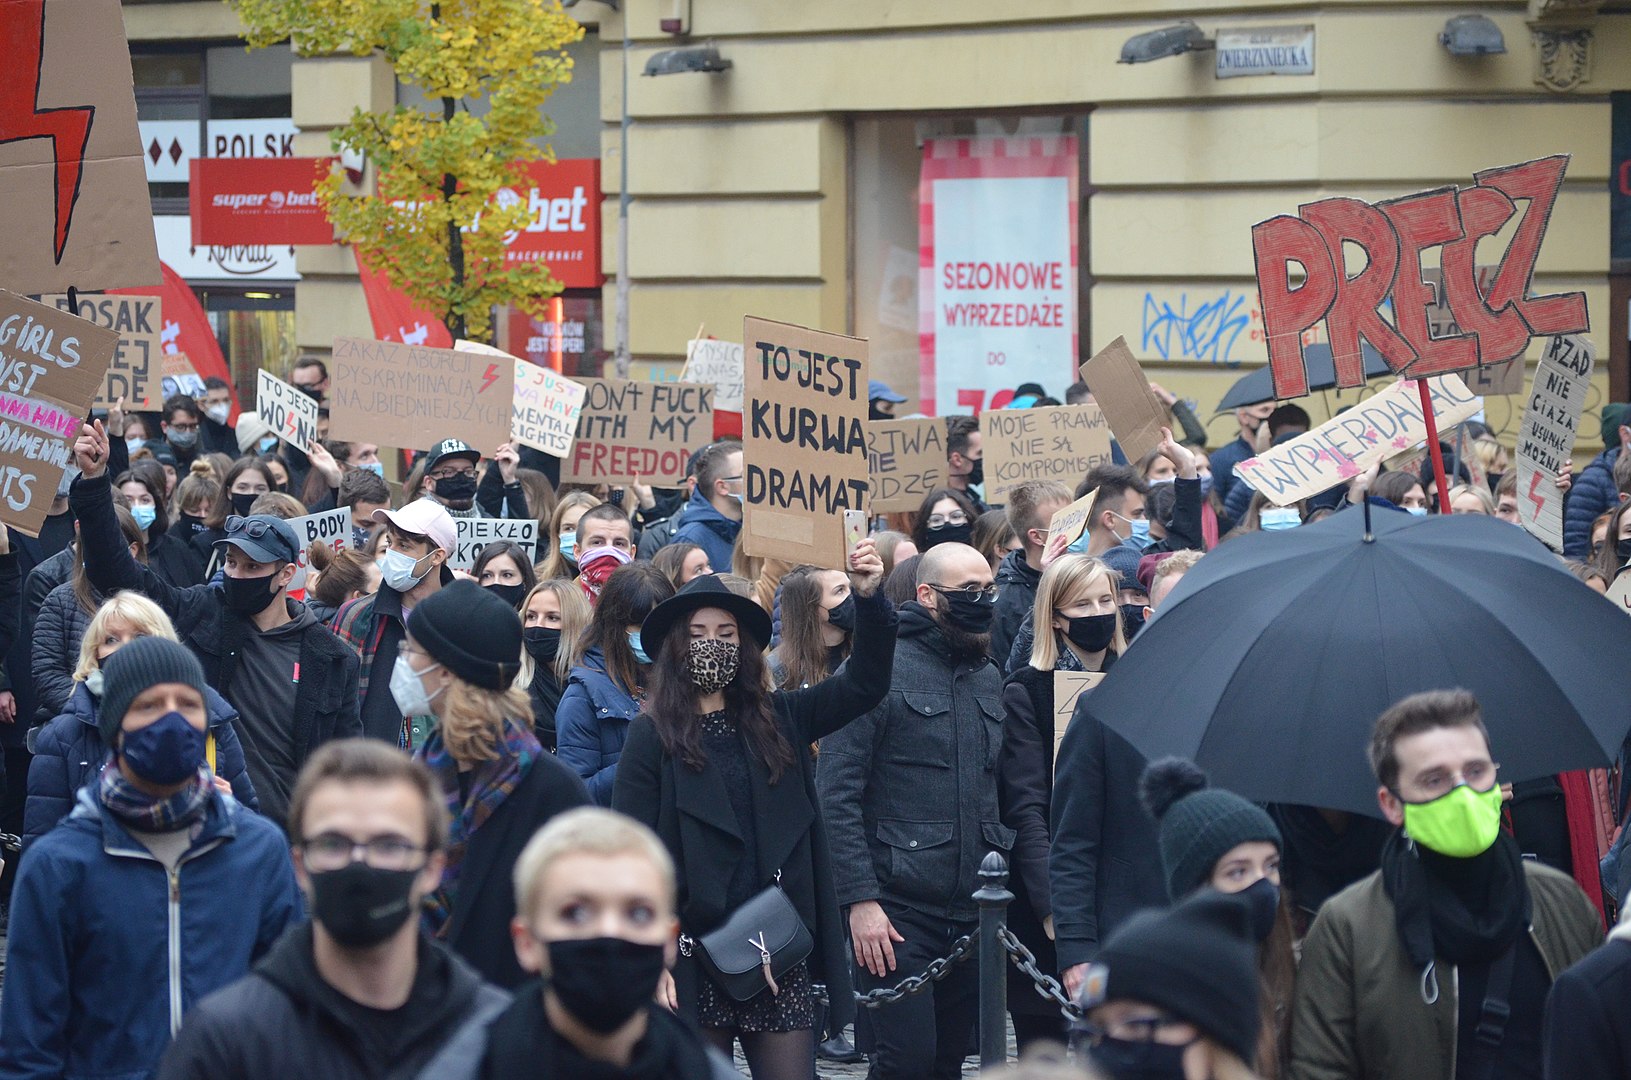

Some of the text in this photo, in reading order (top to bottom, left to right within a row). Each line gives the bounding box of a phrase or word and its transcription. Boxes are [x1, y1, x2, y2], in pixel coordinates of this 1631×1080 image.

[212, 190, 318, 209] super bet
[525, 186, 588, 232] bet
[943, 262, 1063, 290] SEZONOWE
[1251, 153, 1591, 401] PRECZ
[943, 296, 1063, 328] WYPRZEDAŻE
[336, 338, 399, 364] ZAKAZ
[406, 348, 473, 373] ABORCJI
[756, 341, 791, 381] TO
[797, 349, 862, 401] JEST
[986, 351, 1006, 366] DO
[1549, 334, 1590, 379] RZĄD
[261, 374, 317, 419] TO JEST
[533, 372, 578, 397] JUST
[650, 385, 712, 414] FUCK
[31, 405, 81, 438] HAVE
[336, 387, 509, 429] NAJBIEDNIEJSZYCH
[543, 395, 582, 420] HAVE
[649, 415, 697, 443] MY
[751, 398, 868, 460] KURWA
[989, 413, 1037, 439] MOJE
[1011, 436, 1074, 458] NIE SĄ
[1523, 439, 1561, 475] MOŻNA
[994, 452, 1112, 483] KOMPROMISEM
[746, 463, 869, 516] DRAMAT
[306, 514, 345, 543] BODY
[456, 520, 533, 540] PIEKŁO
